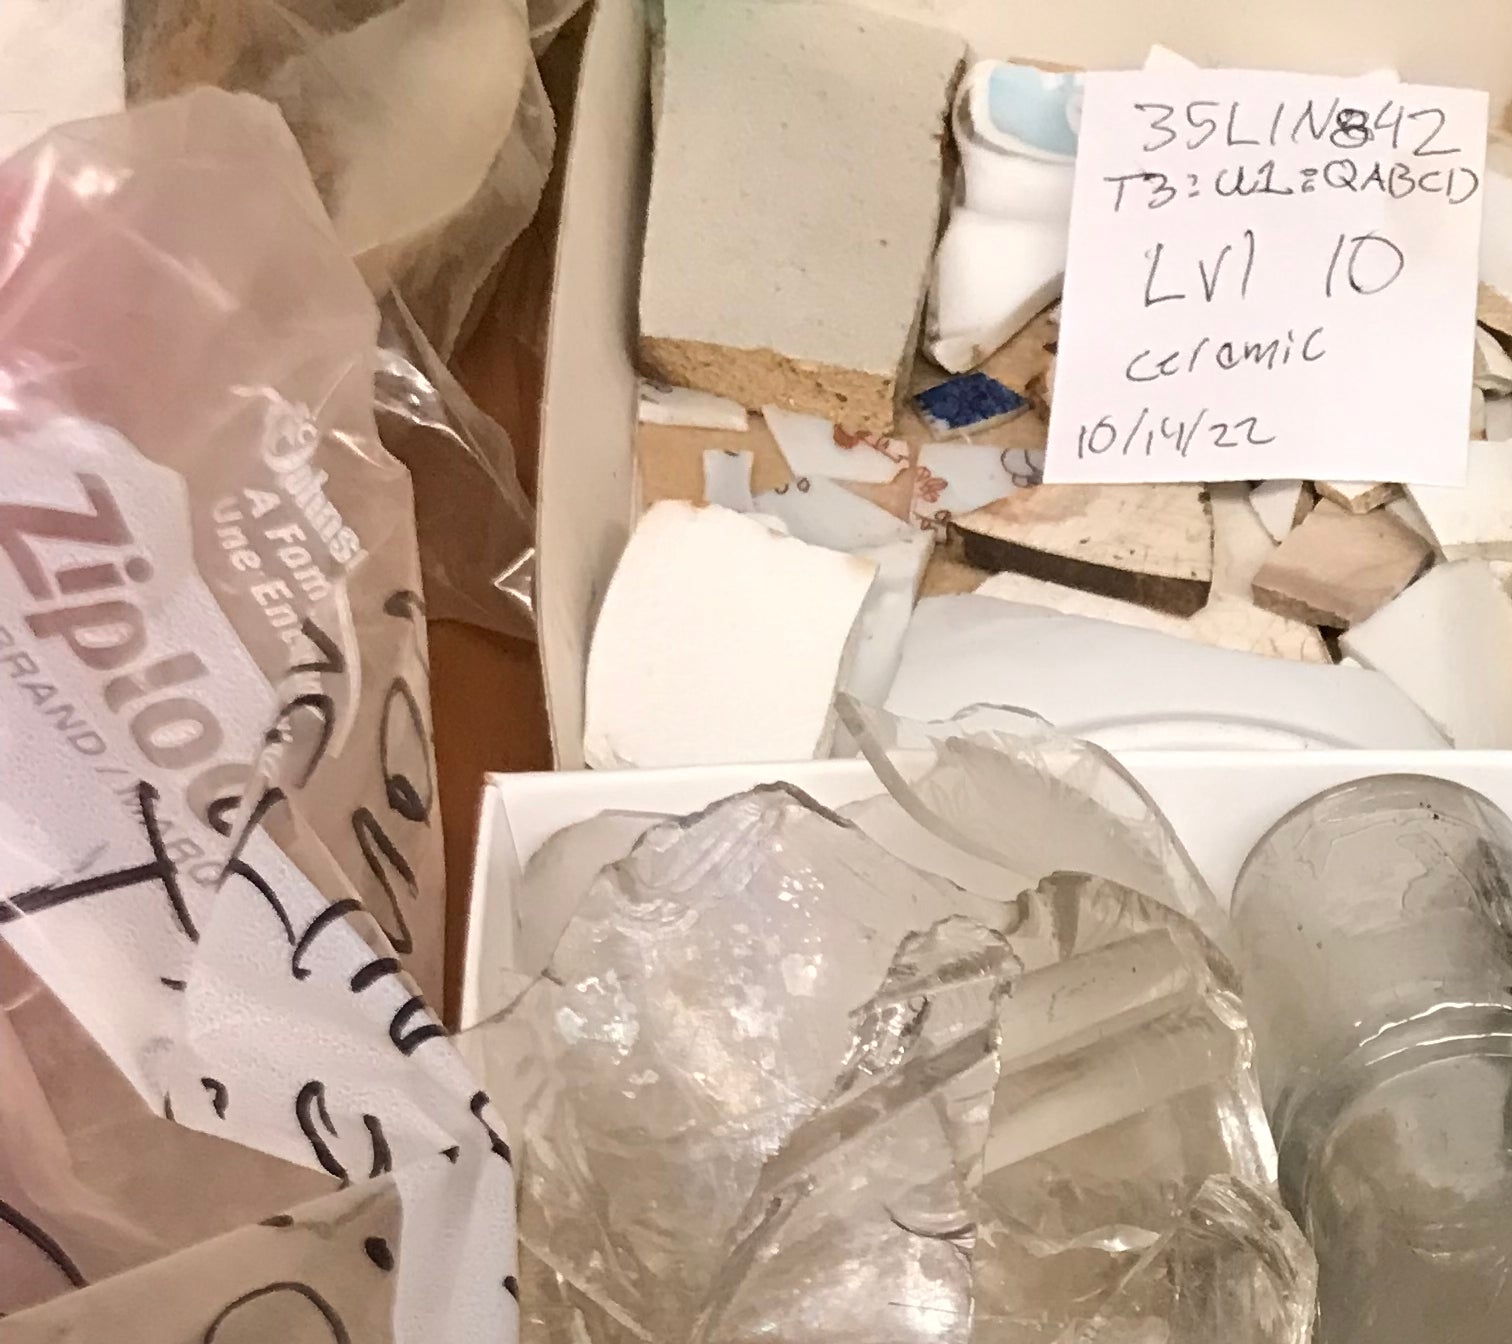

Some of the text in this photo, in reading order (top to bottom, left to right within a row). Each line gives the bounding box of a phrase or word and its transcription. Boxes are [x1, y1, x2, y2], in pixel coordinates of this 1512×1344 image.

[1134, 97, 1462, 157] 35LIN842
[1325, 230, 1405, 299] 10
[1077, 408, 1276, 459] 10/14/22
